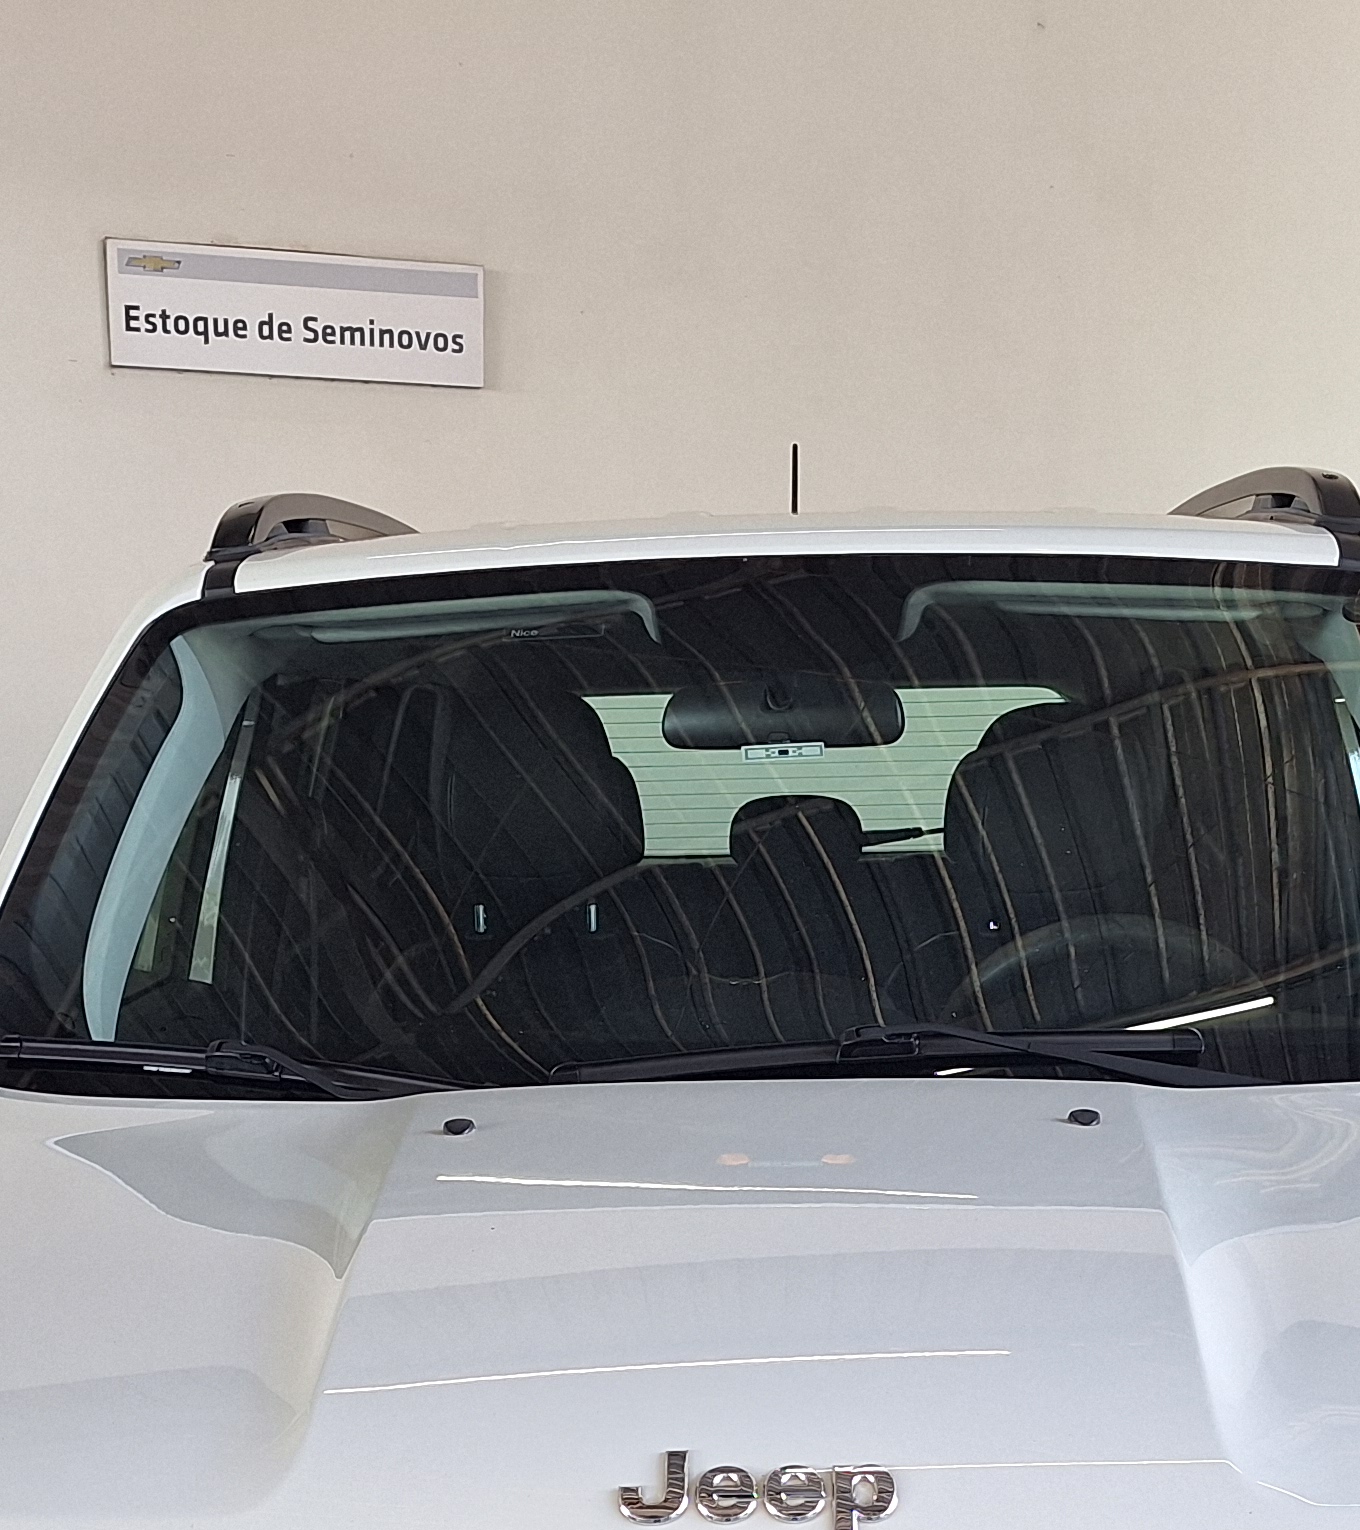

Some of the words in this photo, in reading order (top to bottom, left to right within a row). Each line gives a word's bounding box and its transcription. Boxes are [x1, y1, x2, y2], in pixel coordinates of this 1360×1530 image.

[124, 304, 248, 345] Estoque
[257, 312, 293, 342] de
[302, 316, 465, 354] Seminovos
